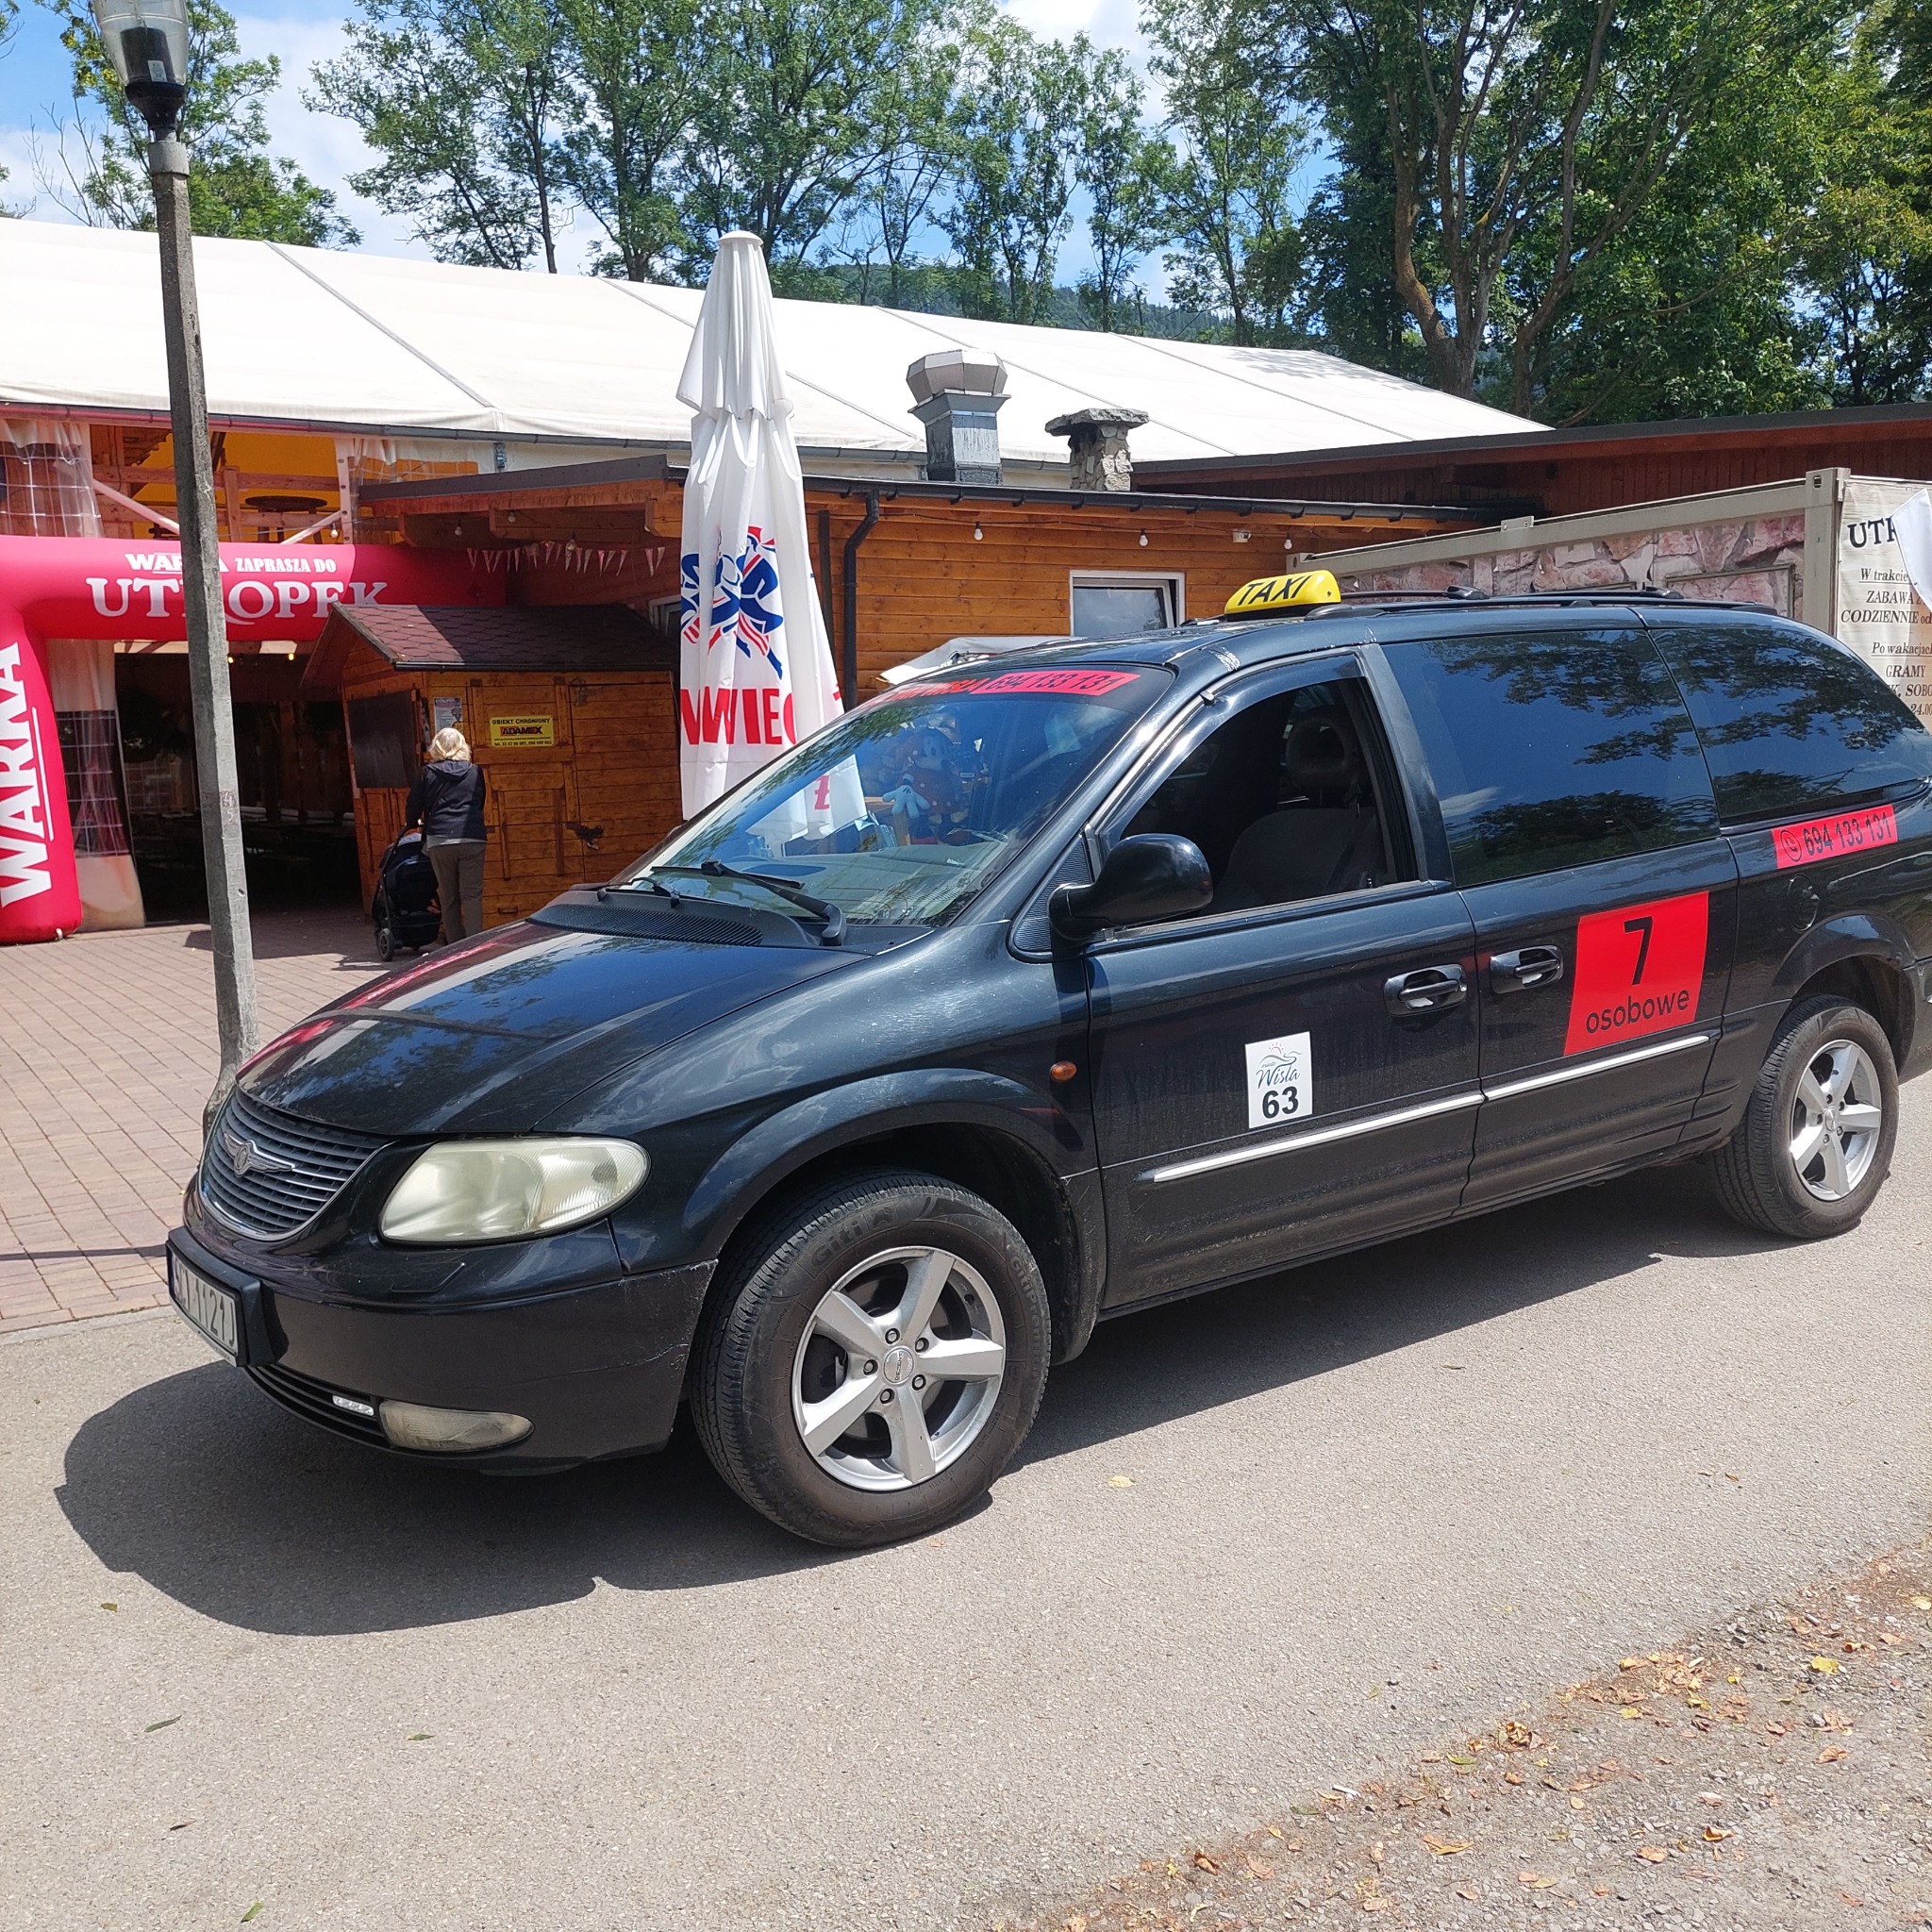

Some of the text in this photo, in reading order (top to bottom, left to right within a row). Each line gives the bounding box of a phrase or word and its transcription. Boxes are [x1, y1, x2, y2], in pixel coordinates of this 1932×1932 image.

[235, 558, 310, 574] ZAPRASZA
[313, 558, 337, 574] DO
[1860, 568, 1908, 582] W trakcie
[1238, 575, 1312, 606] TAXI
[1866, 590, 1914, 605] ZABAWA
[85, 576, 388, 625] UTOPEK
[1840, 609, 1919, 624] CODZIENNIE
[1872, 642, 1886, 654] Po
[1886, 664, 1926, 678] GRAMY
[1025, 673, 1079, 689] 133
[1068, 674, 1126, 691] 131
[1803, 811, 1892, 857] 694 133 131
[1624, 915, 1654, 986] 7
[1586, 989, 1690, 1035] osobowe
[1262, 1086, 1299, 1120] 63
